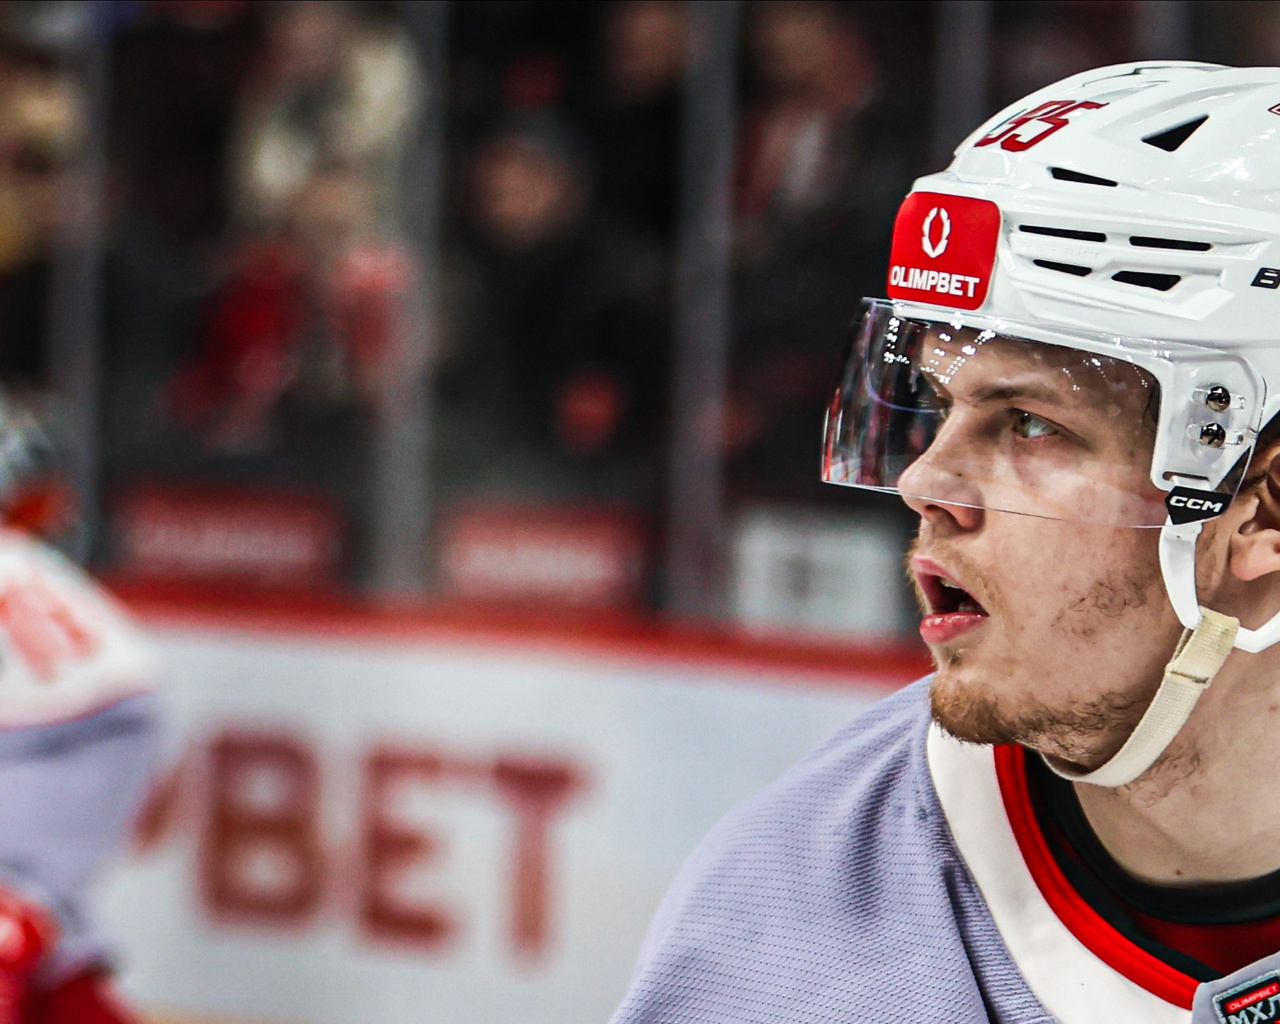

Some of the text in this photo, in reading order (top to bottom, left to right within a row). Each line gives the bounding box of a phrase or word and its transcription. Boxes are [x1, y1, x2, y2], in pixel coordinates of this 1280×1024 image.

[890, 265, 980, 298] OLIMPBET
[1169, 495, 1223, 513] CCM
[134, 728, 590, 965] BET
[1229, 985, 1278, 1010] OLIMPBET
